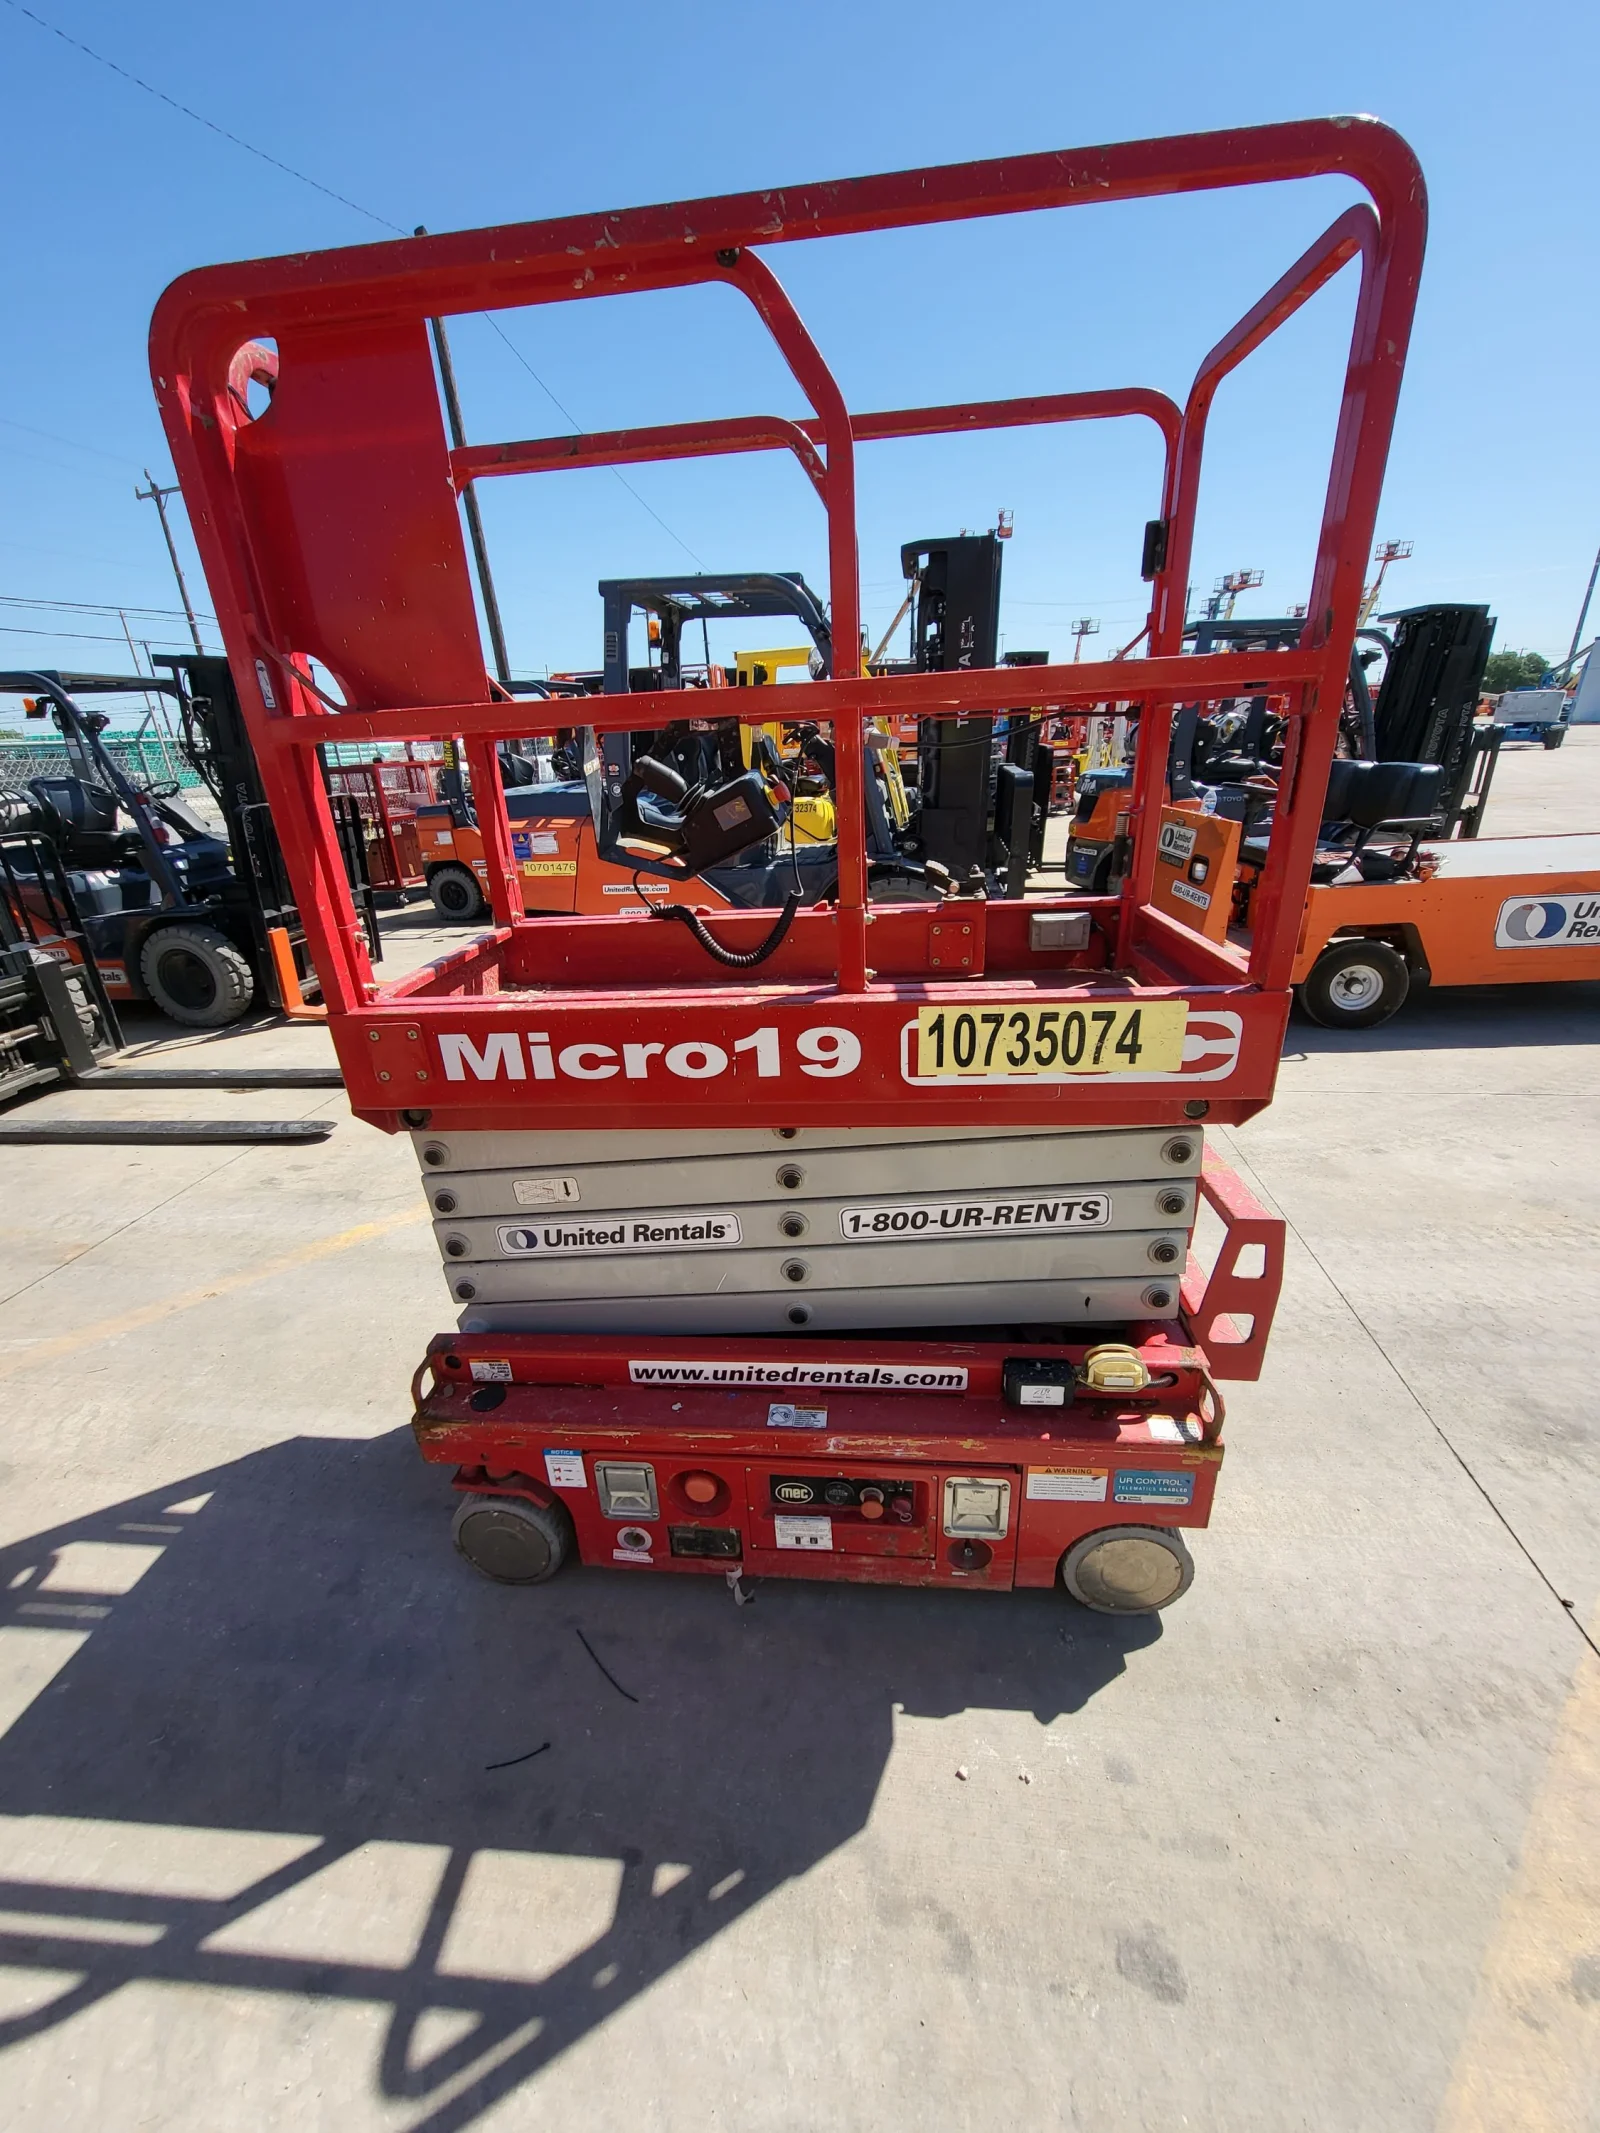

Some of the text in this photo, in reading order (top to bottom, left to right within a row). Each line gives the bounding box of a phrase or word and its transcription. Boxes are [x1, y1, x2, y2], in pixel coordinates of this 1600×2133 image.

[1424, 707, 1450, 759] TOYOTA
[1174, 829, 1193, 845] United
[1172, 840, 1191, 854] Rentals
[524, 862, 576, 872] 10701476
[1173, 883, 1208, 906] 800-UR-RENTS
[1566, 921, 1600, 939] Re
[927, 1008, 1143, 1068] 10735074
[437, 1026, 862, 1081] Micro19
[848, 1200, 1101, 1233] 1-800-UR-RENTS
[543, 1217, 726, 1247] United Rentals
[634, 1366, 964, 1387] www.unitedrentals.com
[1053, 1467, 1093, 1475] WARNING
[1119, 1477, 1183, 1486] UR CONTROL
[781, 1487, 809, 1499] mec
